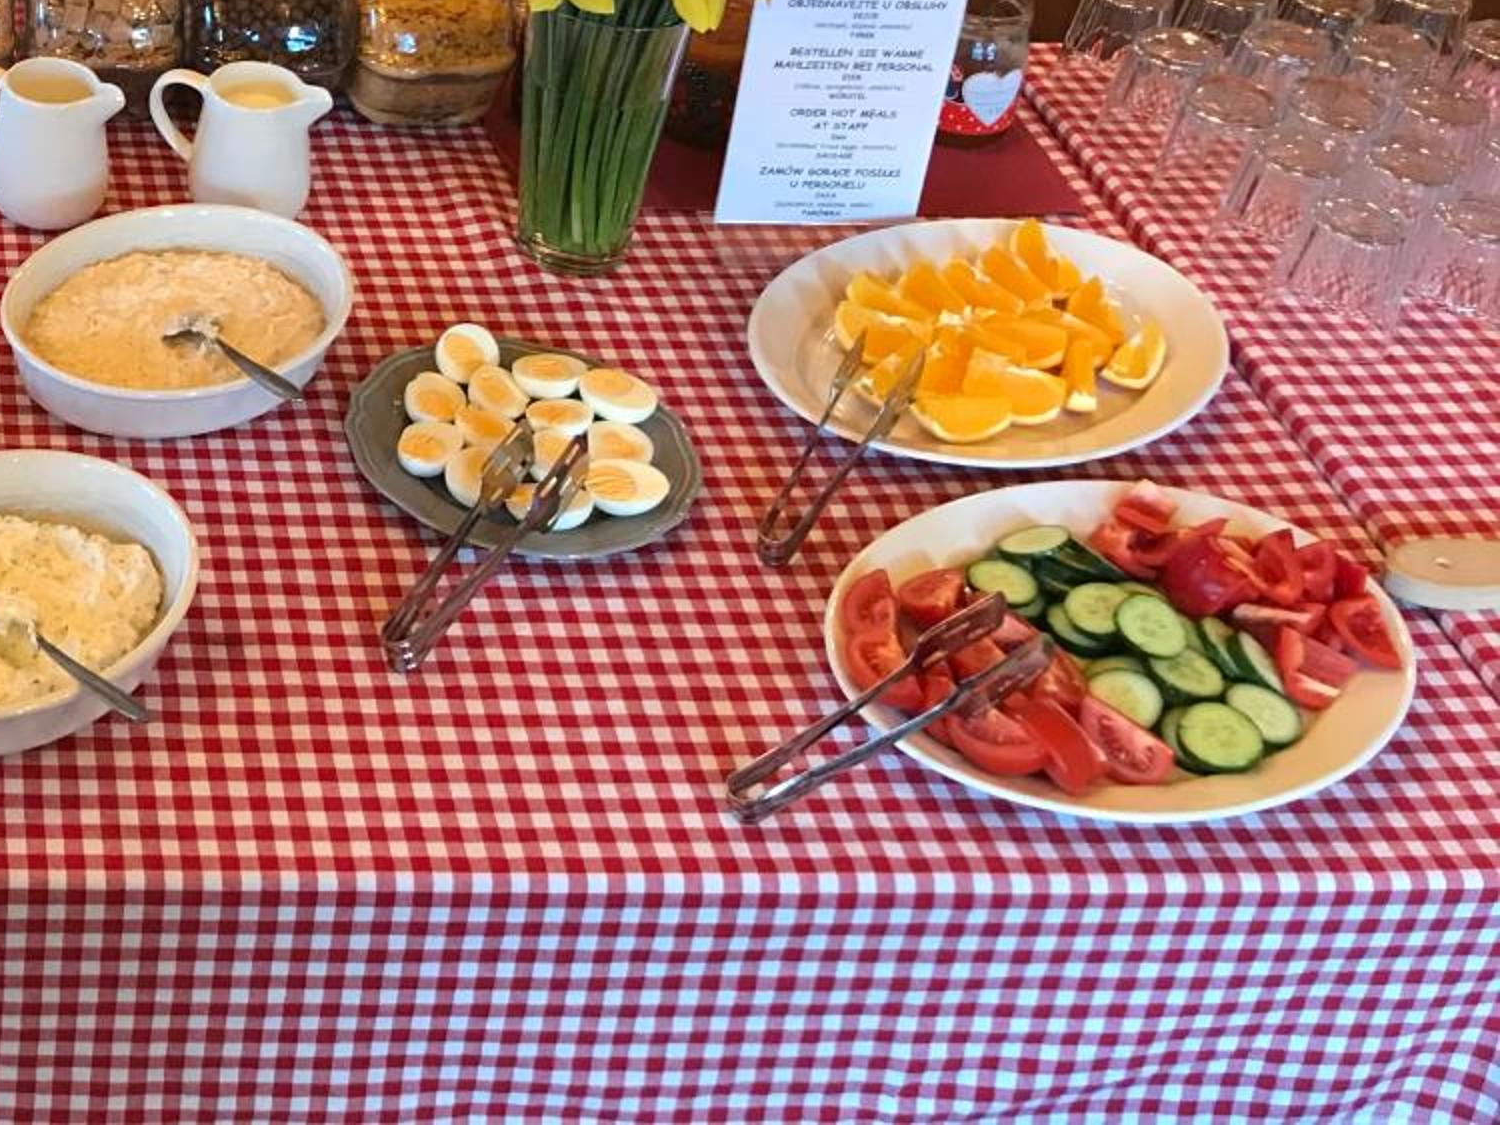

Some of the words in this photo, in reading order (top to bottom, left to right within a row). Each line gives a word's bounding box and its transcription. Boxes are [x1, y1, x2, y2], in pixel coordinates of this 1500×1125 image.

[789, 46, 853, 58] BESTELLEN
[875, 62, 933, 73] PERSONAL
[789, 107, 827, 118] ORDER
[831, 107, 857, 118] HOT
[859, 108, 898, 120] MEALS
[832, 121, 869, 132] STAFF
